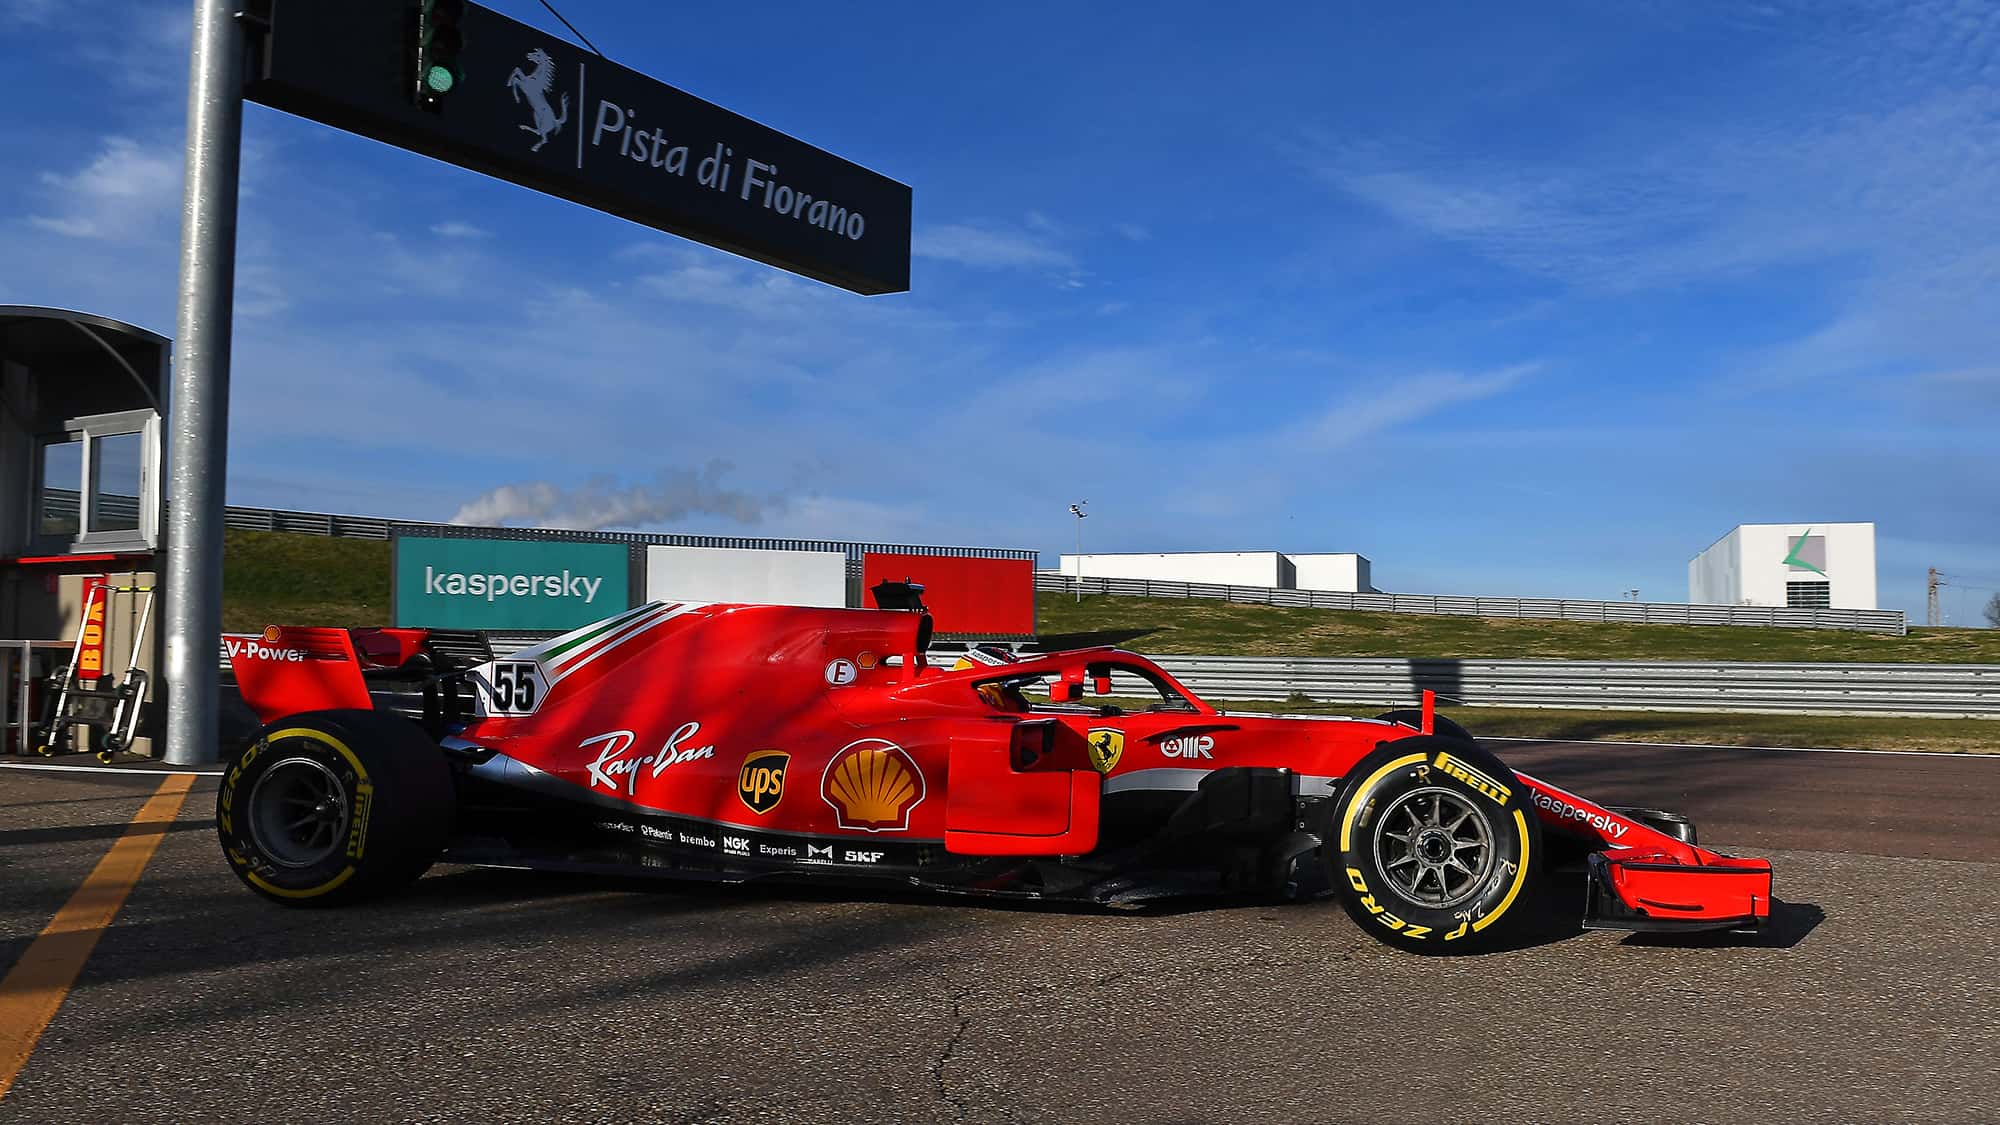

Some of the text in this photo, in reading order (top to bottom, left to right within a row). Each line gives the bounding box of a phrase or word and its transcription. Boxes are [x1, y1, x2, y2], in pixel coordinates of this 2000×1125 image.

[592, 99, 865, 241] Pista di Fiorano
[425, 566, 602, 603] kaspersky
[493, 664, 535, 712] 55
[833, 662, 848, 683] E
[222, 744, 258, 836] ZERO
[741, 767, 783, 804] ups
[1434, 751, 1513, 807] PIRELLI
[346, 783, 374, 859] PIRELLI
[1530, 787, 1629, 838] kaspersky
[679, 832, 716, 848] brembo
[723, 836, 750, 851] NGK
[760, 844, 797, 856] Experis
[844, 851, 884, 862] SKF
[1346, 867, 1433, 940] ZERO
[1444, 921, 1469, 941] P
